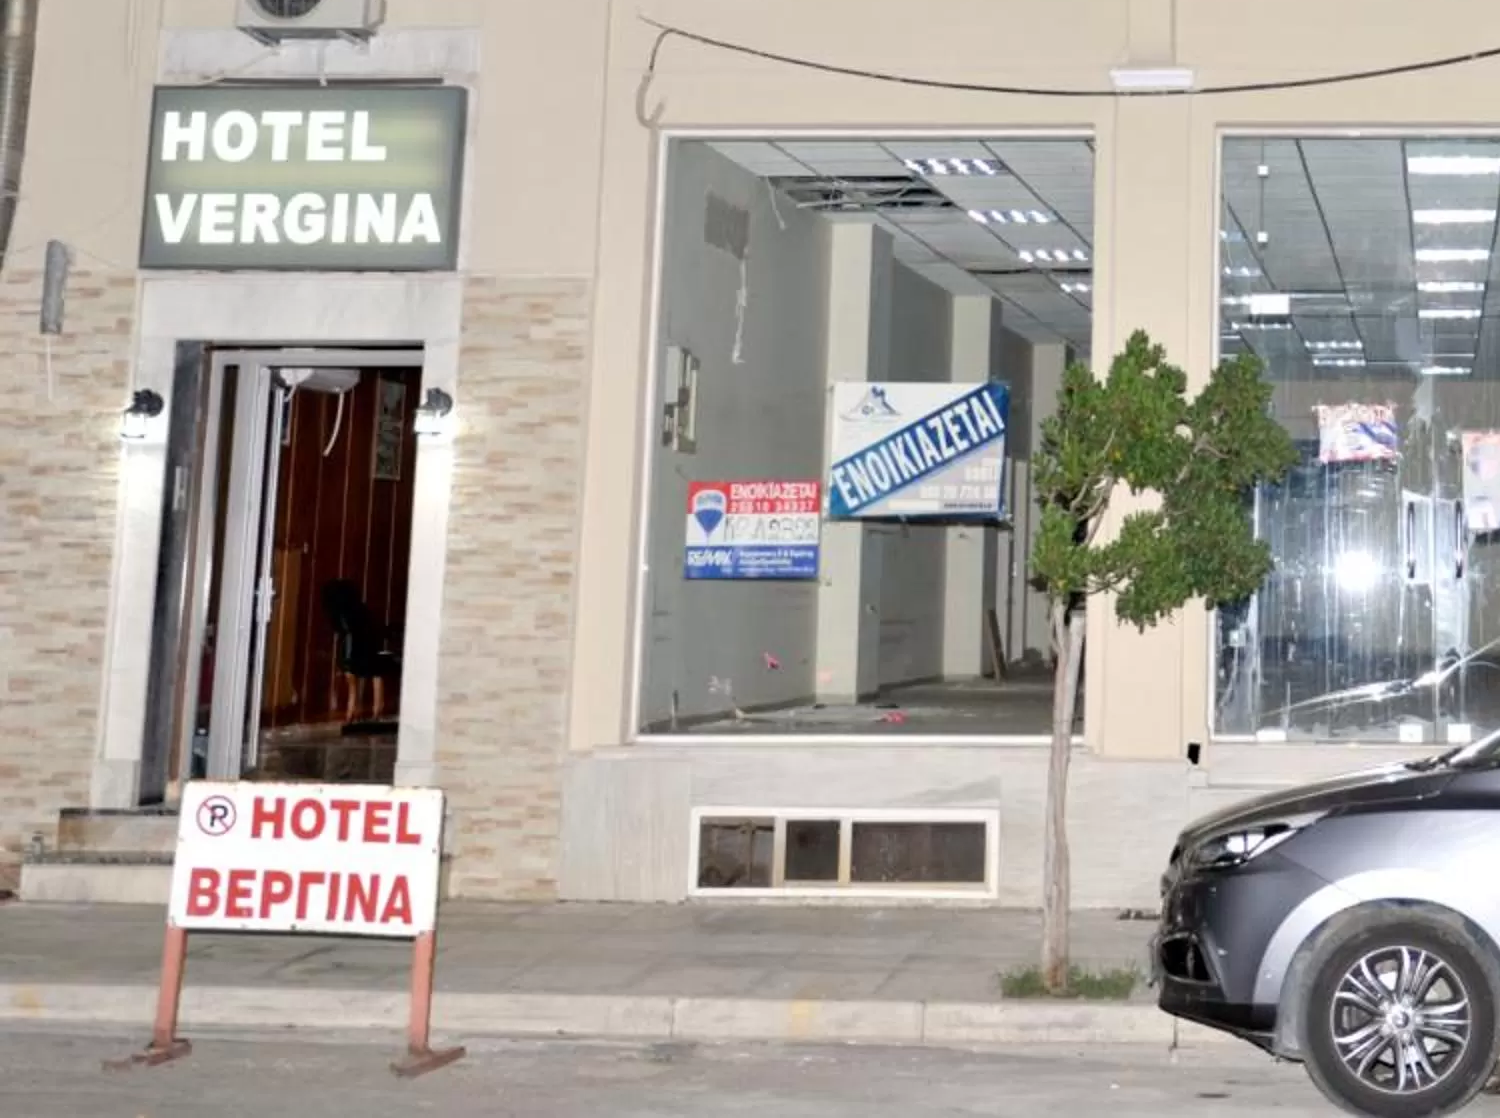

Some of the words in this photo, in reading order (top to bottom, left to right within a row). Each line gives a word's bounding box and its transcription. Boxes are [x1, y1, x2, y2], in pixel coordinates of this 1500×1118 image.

[161, 110, 387, 162] HOTEL
[155, 192, 441, 244] VERGINA
[832, 389, 1006, 510] ΕΝΟΙΚΙΑΖΕΤΑΙ
[730, 482, 817, 499] ΕΝΟΙΚΙΑΖΕΤΑΙ
[250, 796, 422, 845] HOTEL
[186, 866, 414, 925] ΒΕΡΓΙΝΑ
